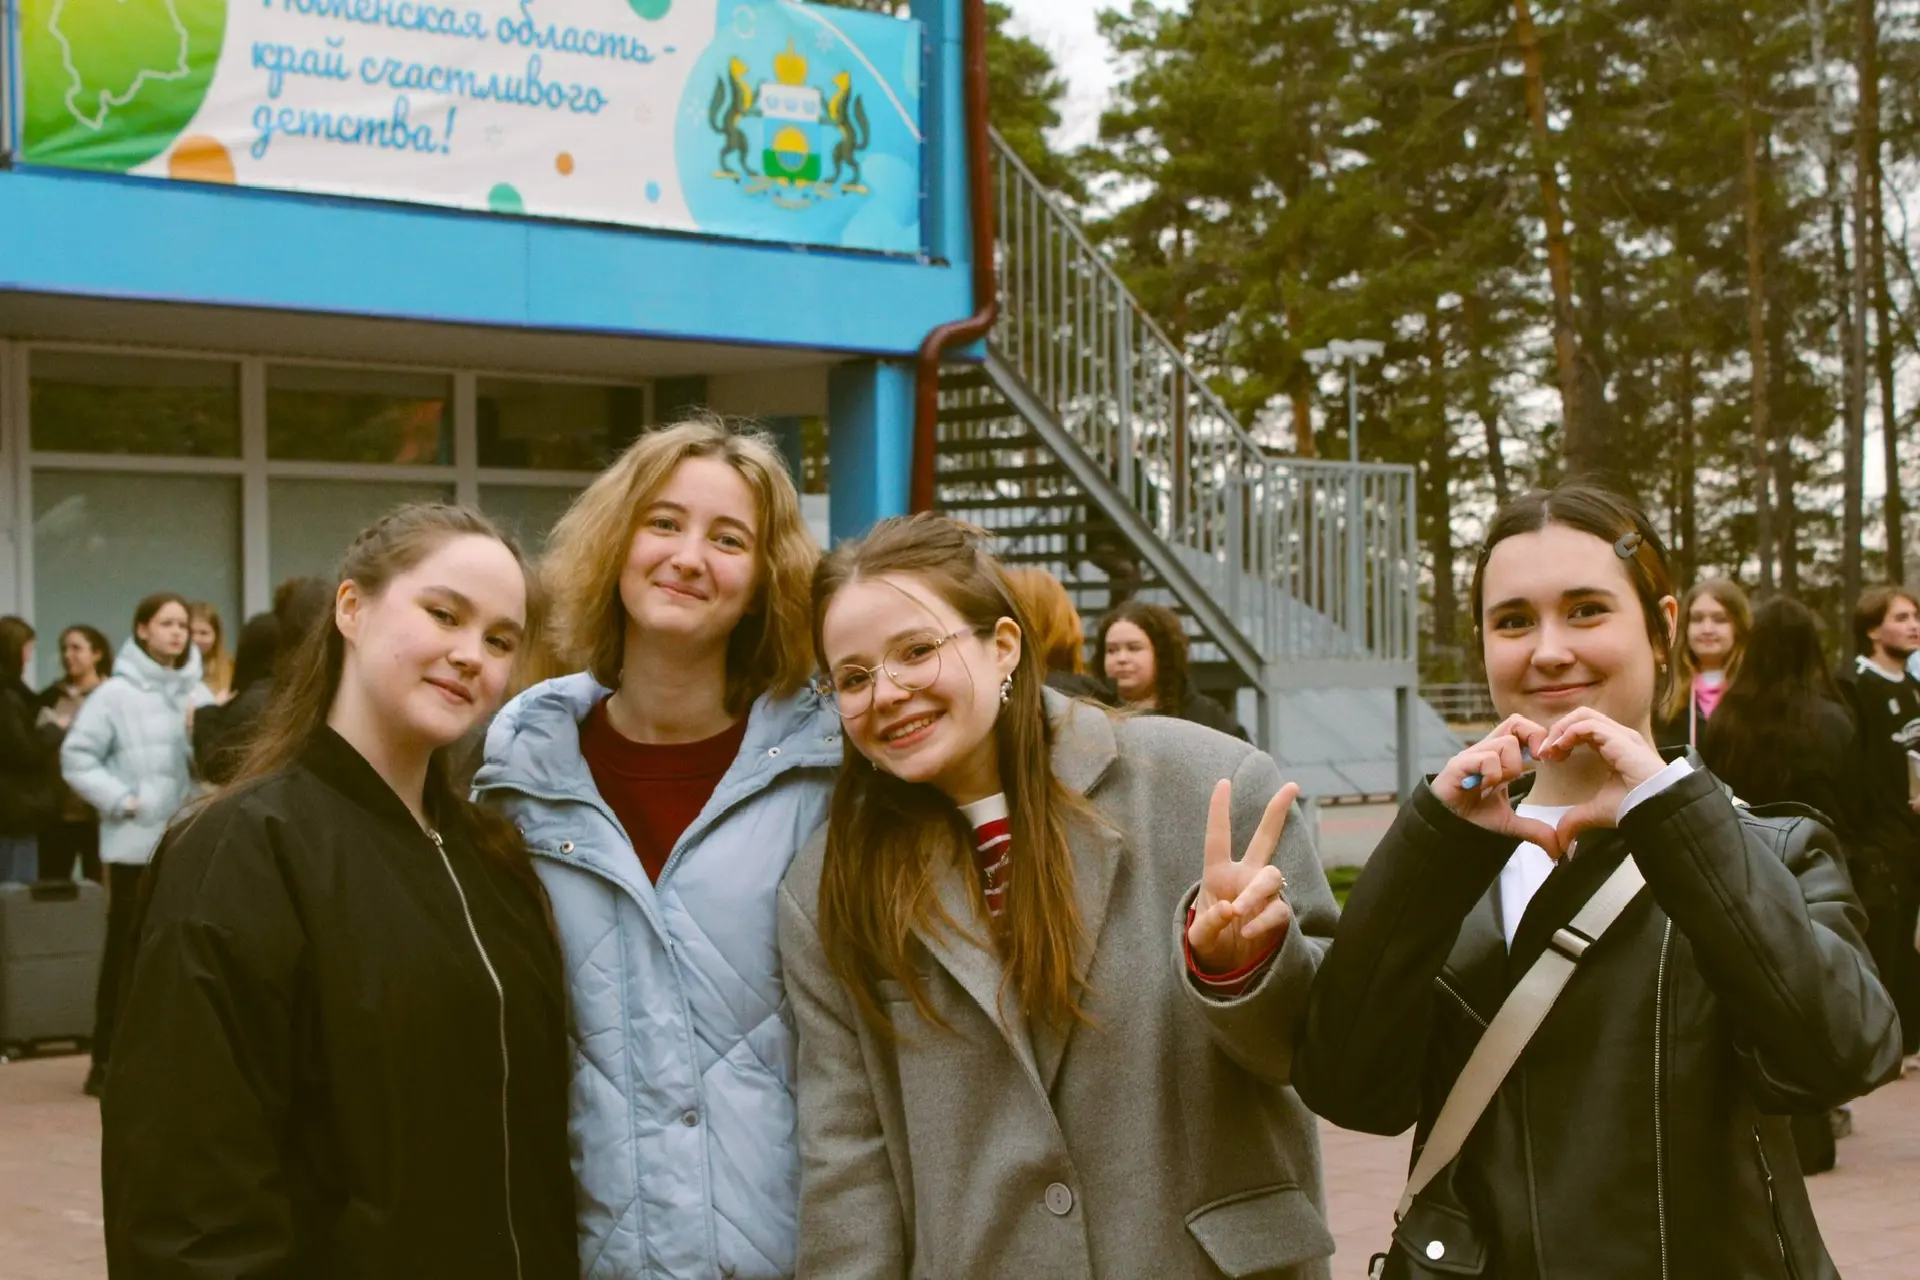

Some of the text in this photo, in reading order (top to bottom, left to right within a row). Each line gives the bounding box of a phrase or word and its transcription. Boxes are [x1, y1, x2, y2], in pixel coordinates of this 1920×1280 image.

[263, 0, 490, 40] юменская
[496, 0, 656, 63] область
[251, 36, 609, 114] край счастливого
[251, 94, 457, 160] детства!
